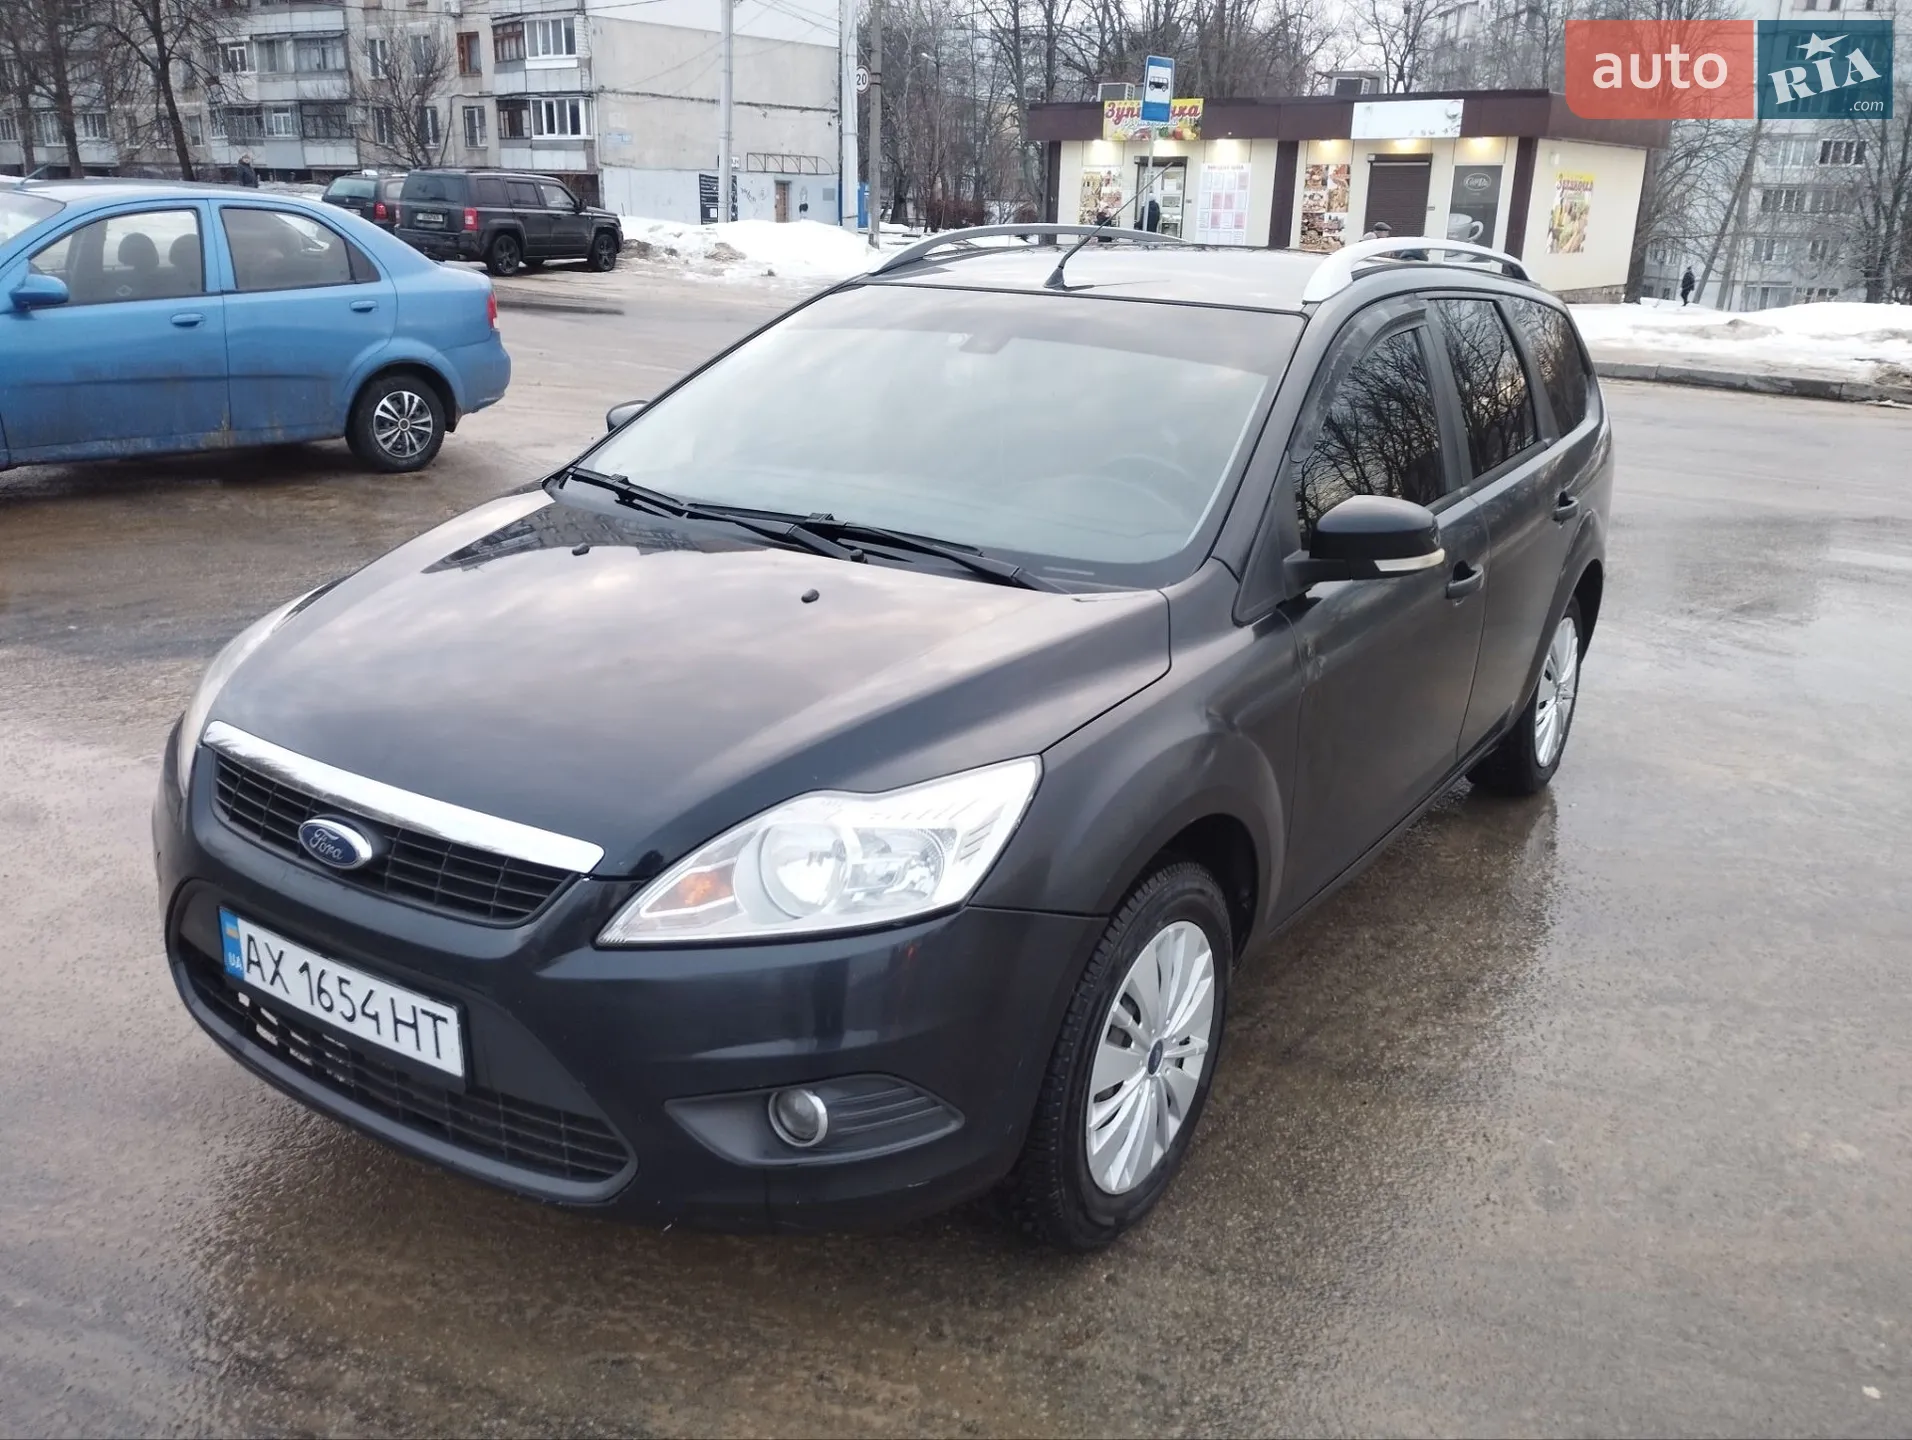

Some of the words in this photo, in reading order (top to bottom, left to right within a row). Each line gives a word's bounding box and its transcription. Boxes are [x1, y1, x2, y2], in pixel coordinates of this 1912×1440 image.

[857, 73, 867, 85] 20
[309, 828, 344, 860] Ford
[228, 951, 243, 971] UA
[298, 960, 381, 1036] 1654
